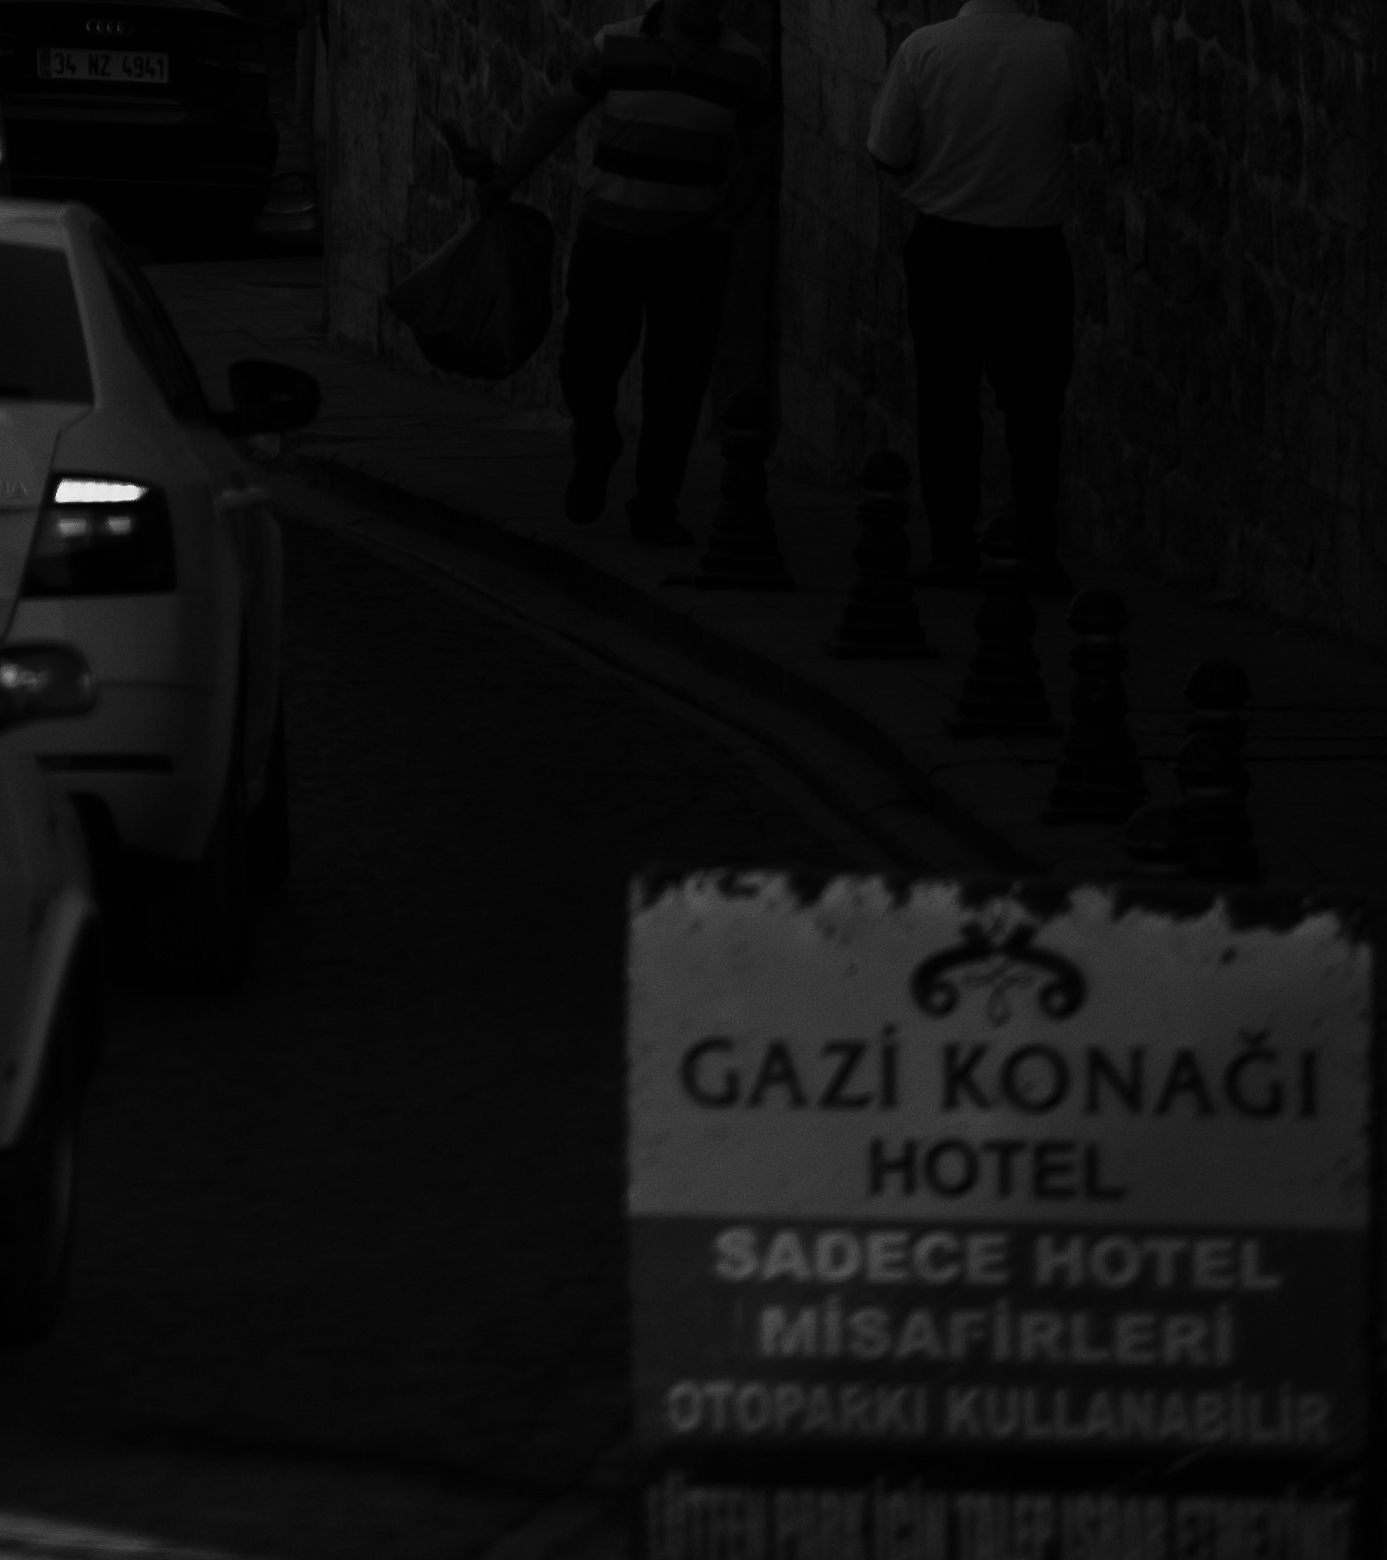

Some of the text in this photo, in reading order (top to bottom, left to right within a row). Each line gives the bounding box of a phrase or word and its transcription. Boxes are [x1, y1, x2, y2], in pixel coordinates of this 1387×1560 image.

[53, 52, 165, 80] 34 NZ 4941
[679, 1024, 1320, 1120] GAZİ KONAĞI
[867, 1137, 1127, 1200] HOTEL
[713, 1226, 1283, 1290] SADECE HOTEL
[756, 1294, 1236, 1368] MİSAFİRLERİ
[665, 1377, 1333, 1444] OTOPARKI KULLANABİLİR
